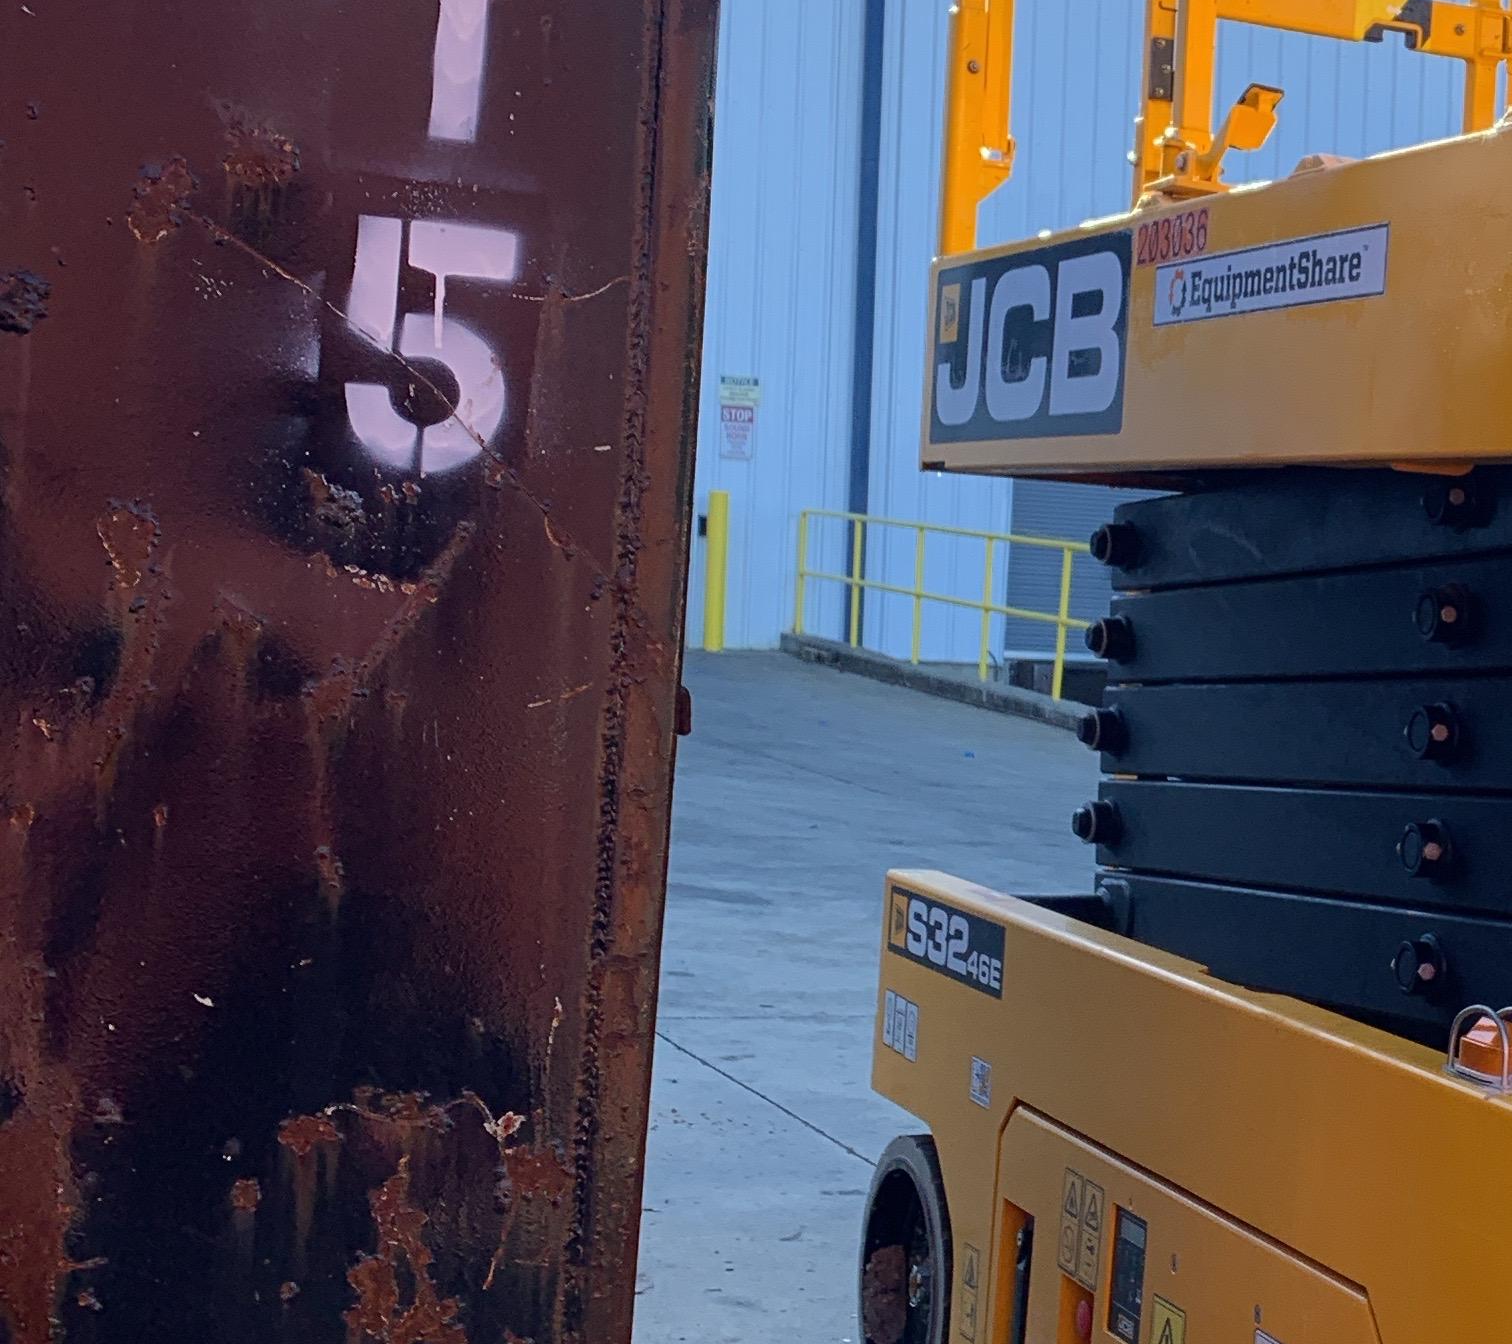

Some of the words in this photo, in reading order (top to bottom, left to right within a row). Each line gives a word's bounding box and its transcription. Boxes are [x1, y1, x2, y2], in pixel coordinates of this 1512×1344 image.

[1137, 207, 1209, 265] 203036
[1189, 248, 1363, 314] EquipmentShare
[936, 250, 1123, 426] JCB
[722, 407, 752, 422] STOP
